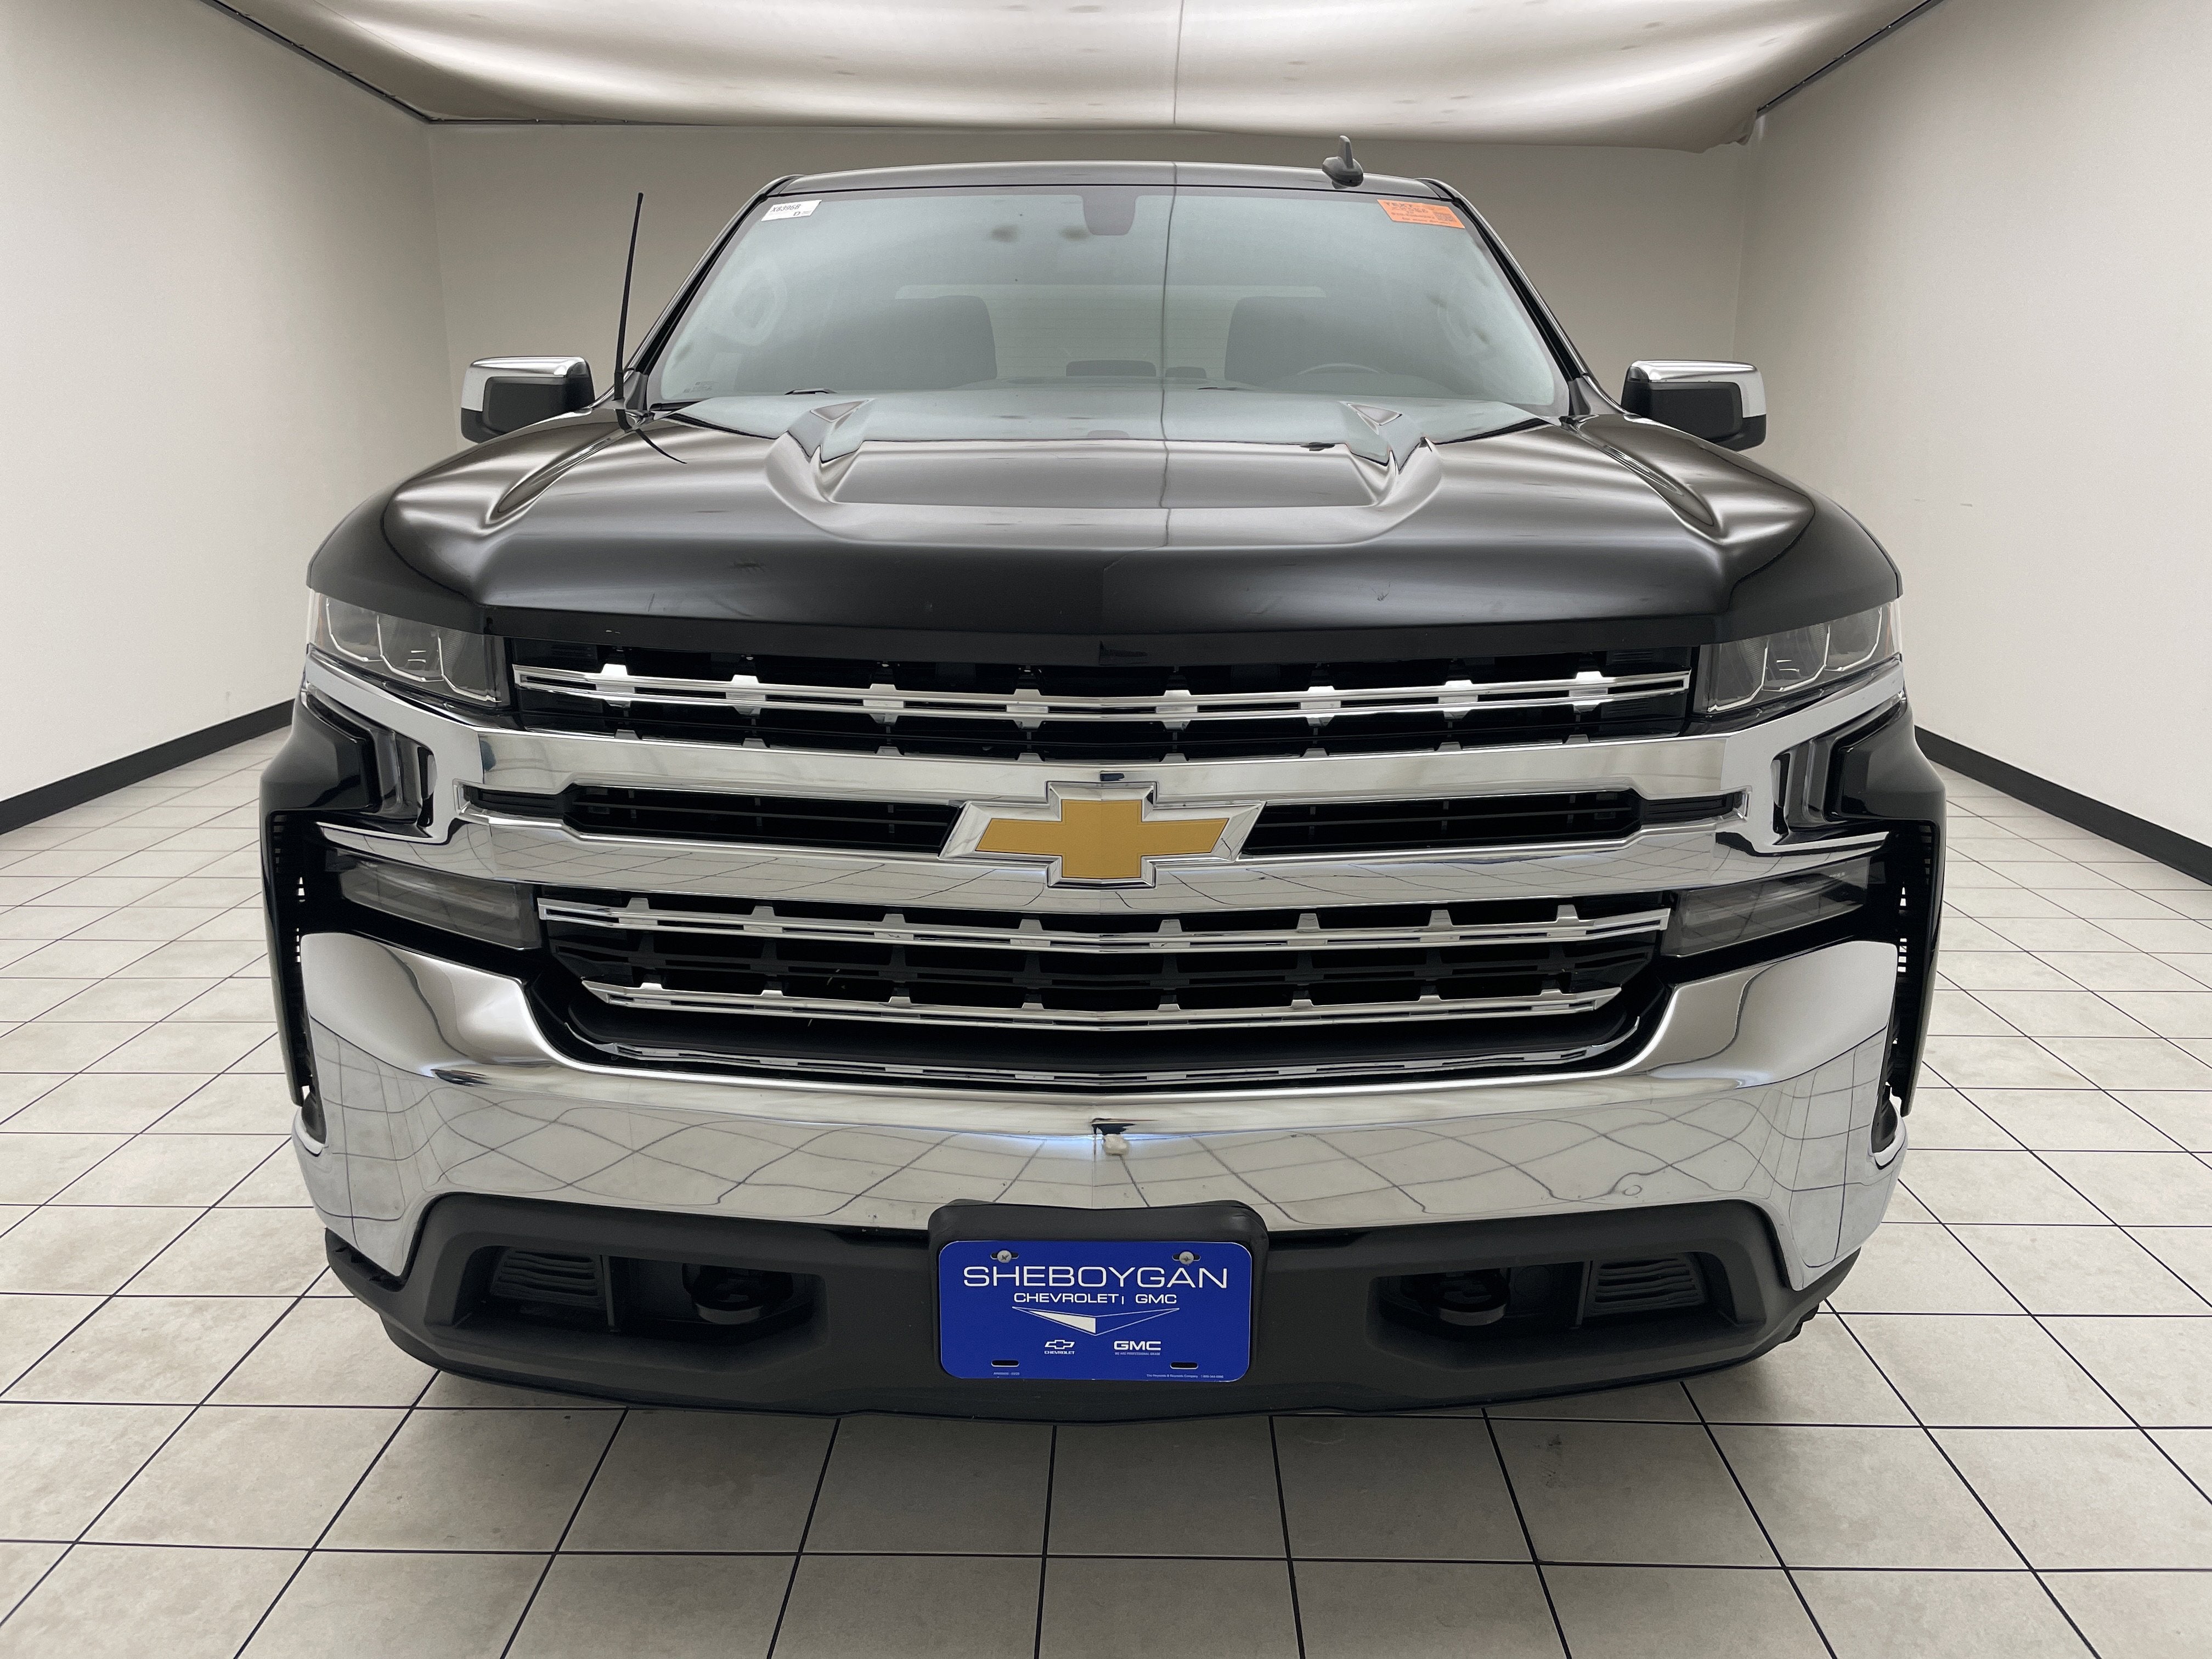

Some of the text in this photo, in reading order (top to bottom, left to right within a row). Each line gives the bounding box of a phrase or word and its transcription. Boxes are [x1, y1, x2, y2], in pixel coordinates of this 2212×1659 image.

[963, 1266, 1227, 1288] SHEBOYGAN
[1135, 1294, 1177, 1304] GMC
[1114, 1341, 1161, 1351] GMC
